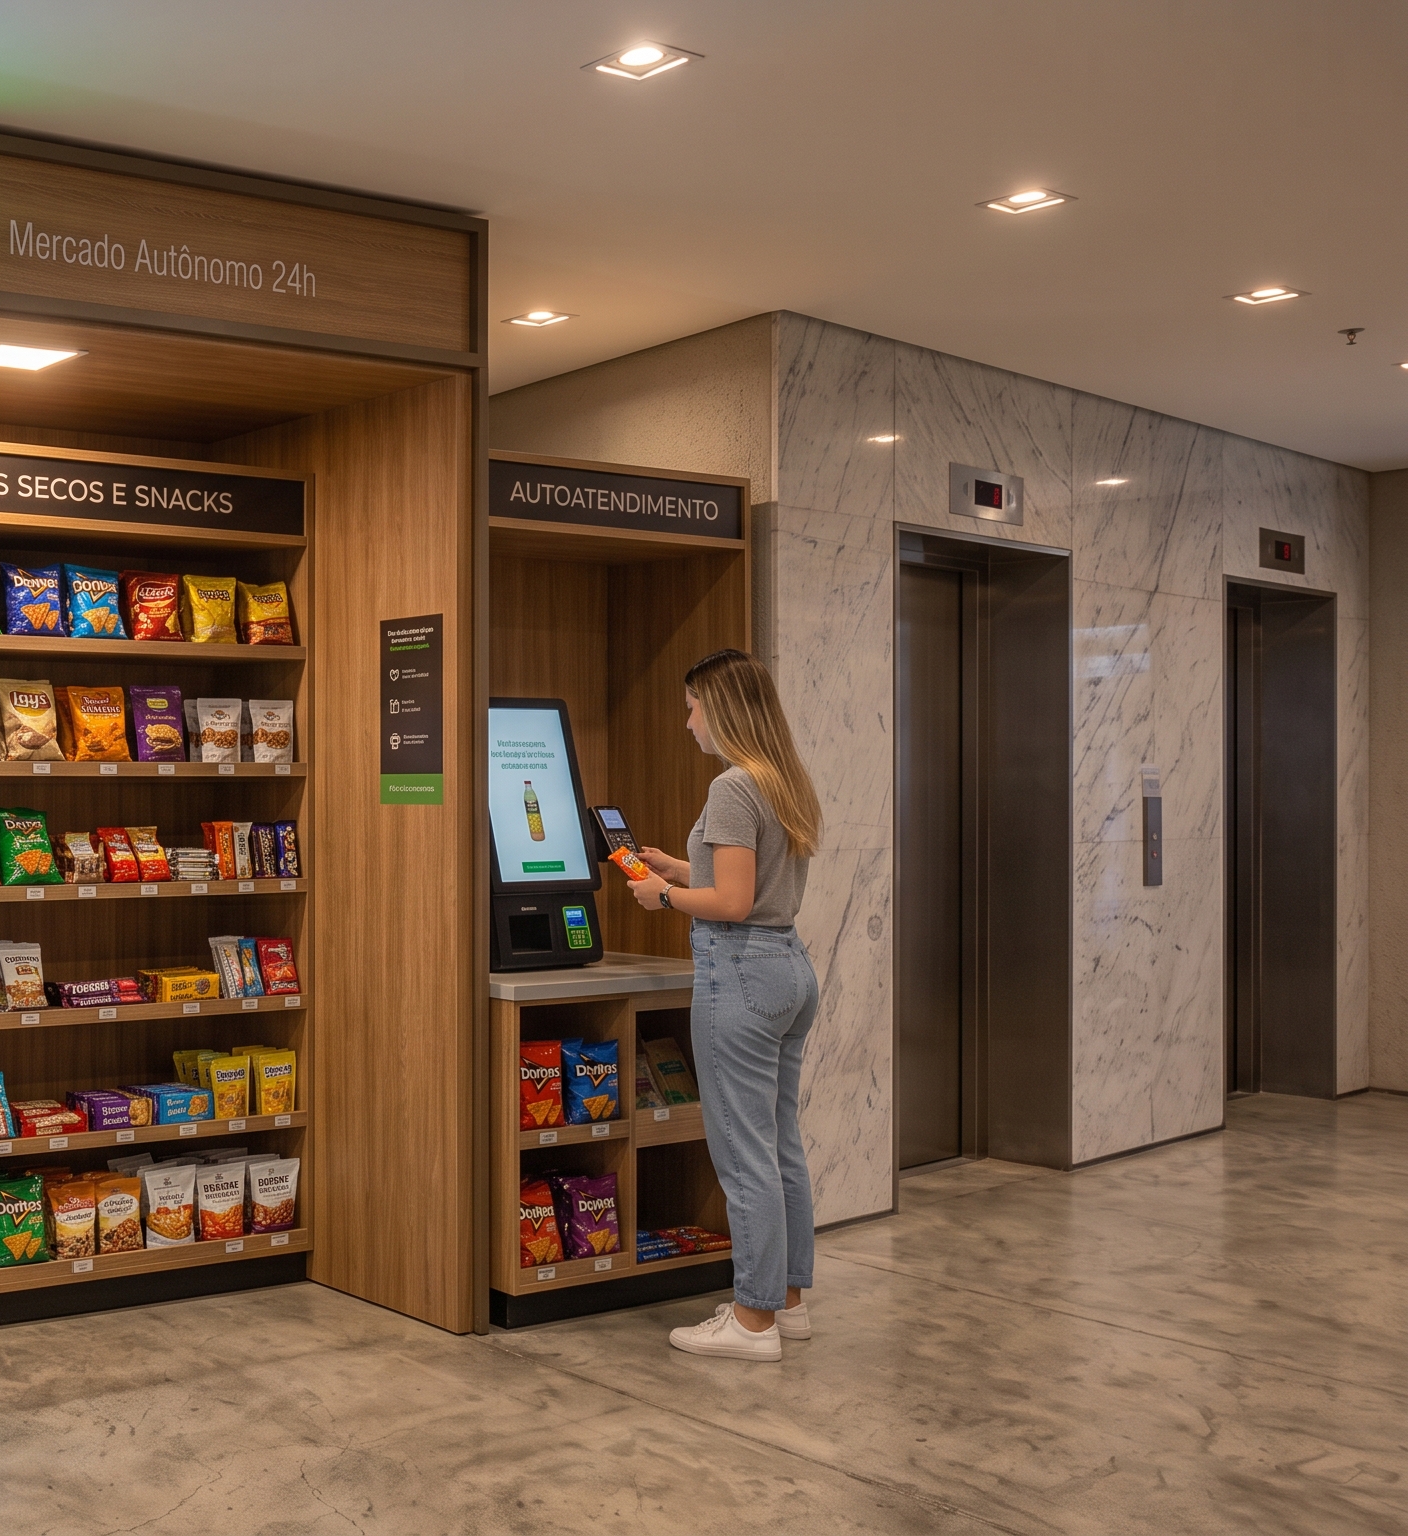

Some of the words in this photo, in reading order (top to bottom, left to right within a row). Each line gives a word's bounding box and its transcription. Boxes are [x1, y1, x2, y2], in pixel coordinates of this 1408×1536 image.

[8, 219, 126, 270] Mercado
[134, 238, 264, 291] Autônomo
[272, 259, 317, 298] 24h
[17, 475, 105, 504] SECOS
[113, 483, 127, 506] E
[134, 485, 234, 515] SNACKS
[509, 481, 719, 521] AUTOATENDIMENTO
